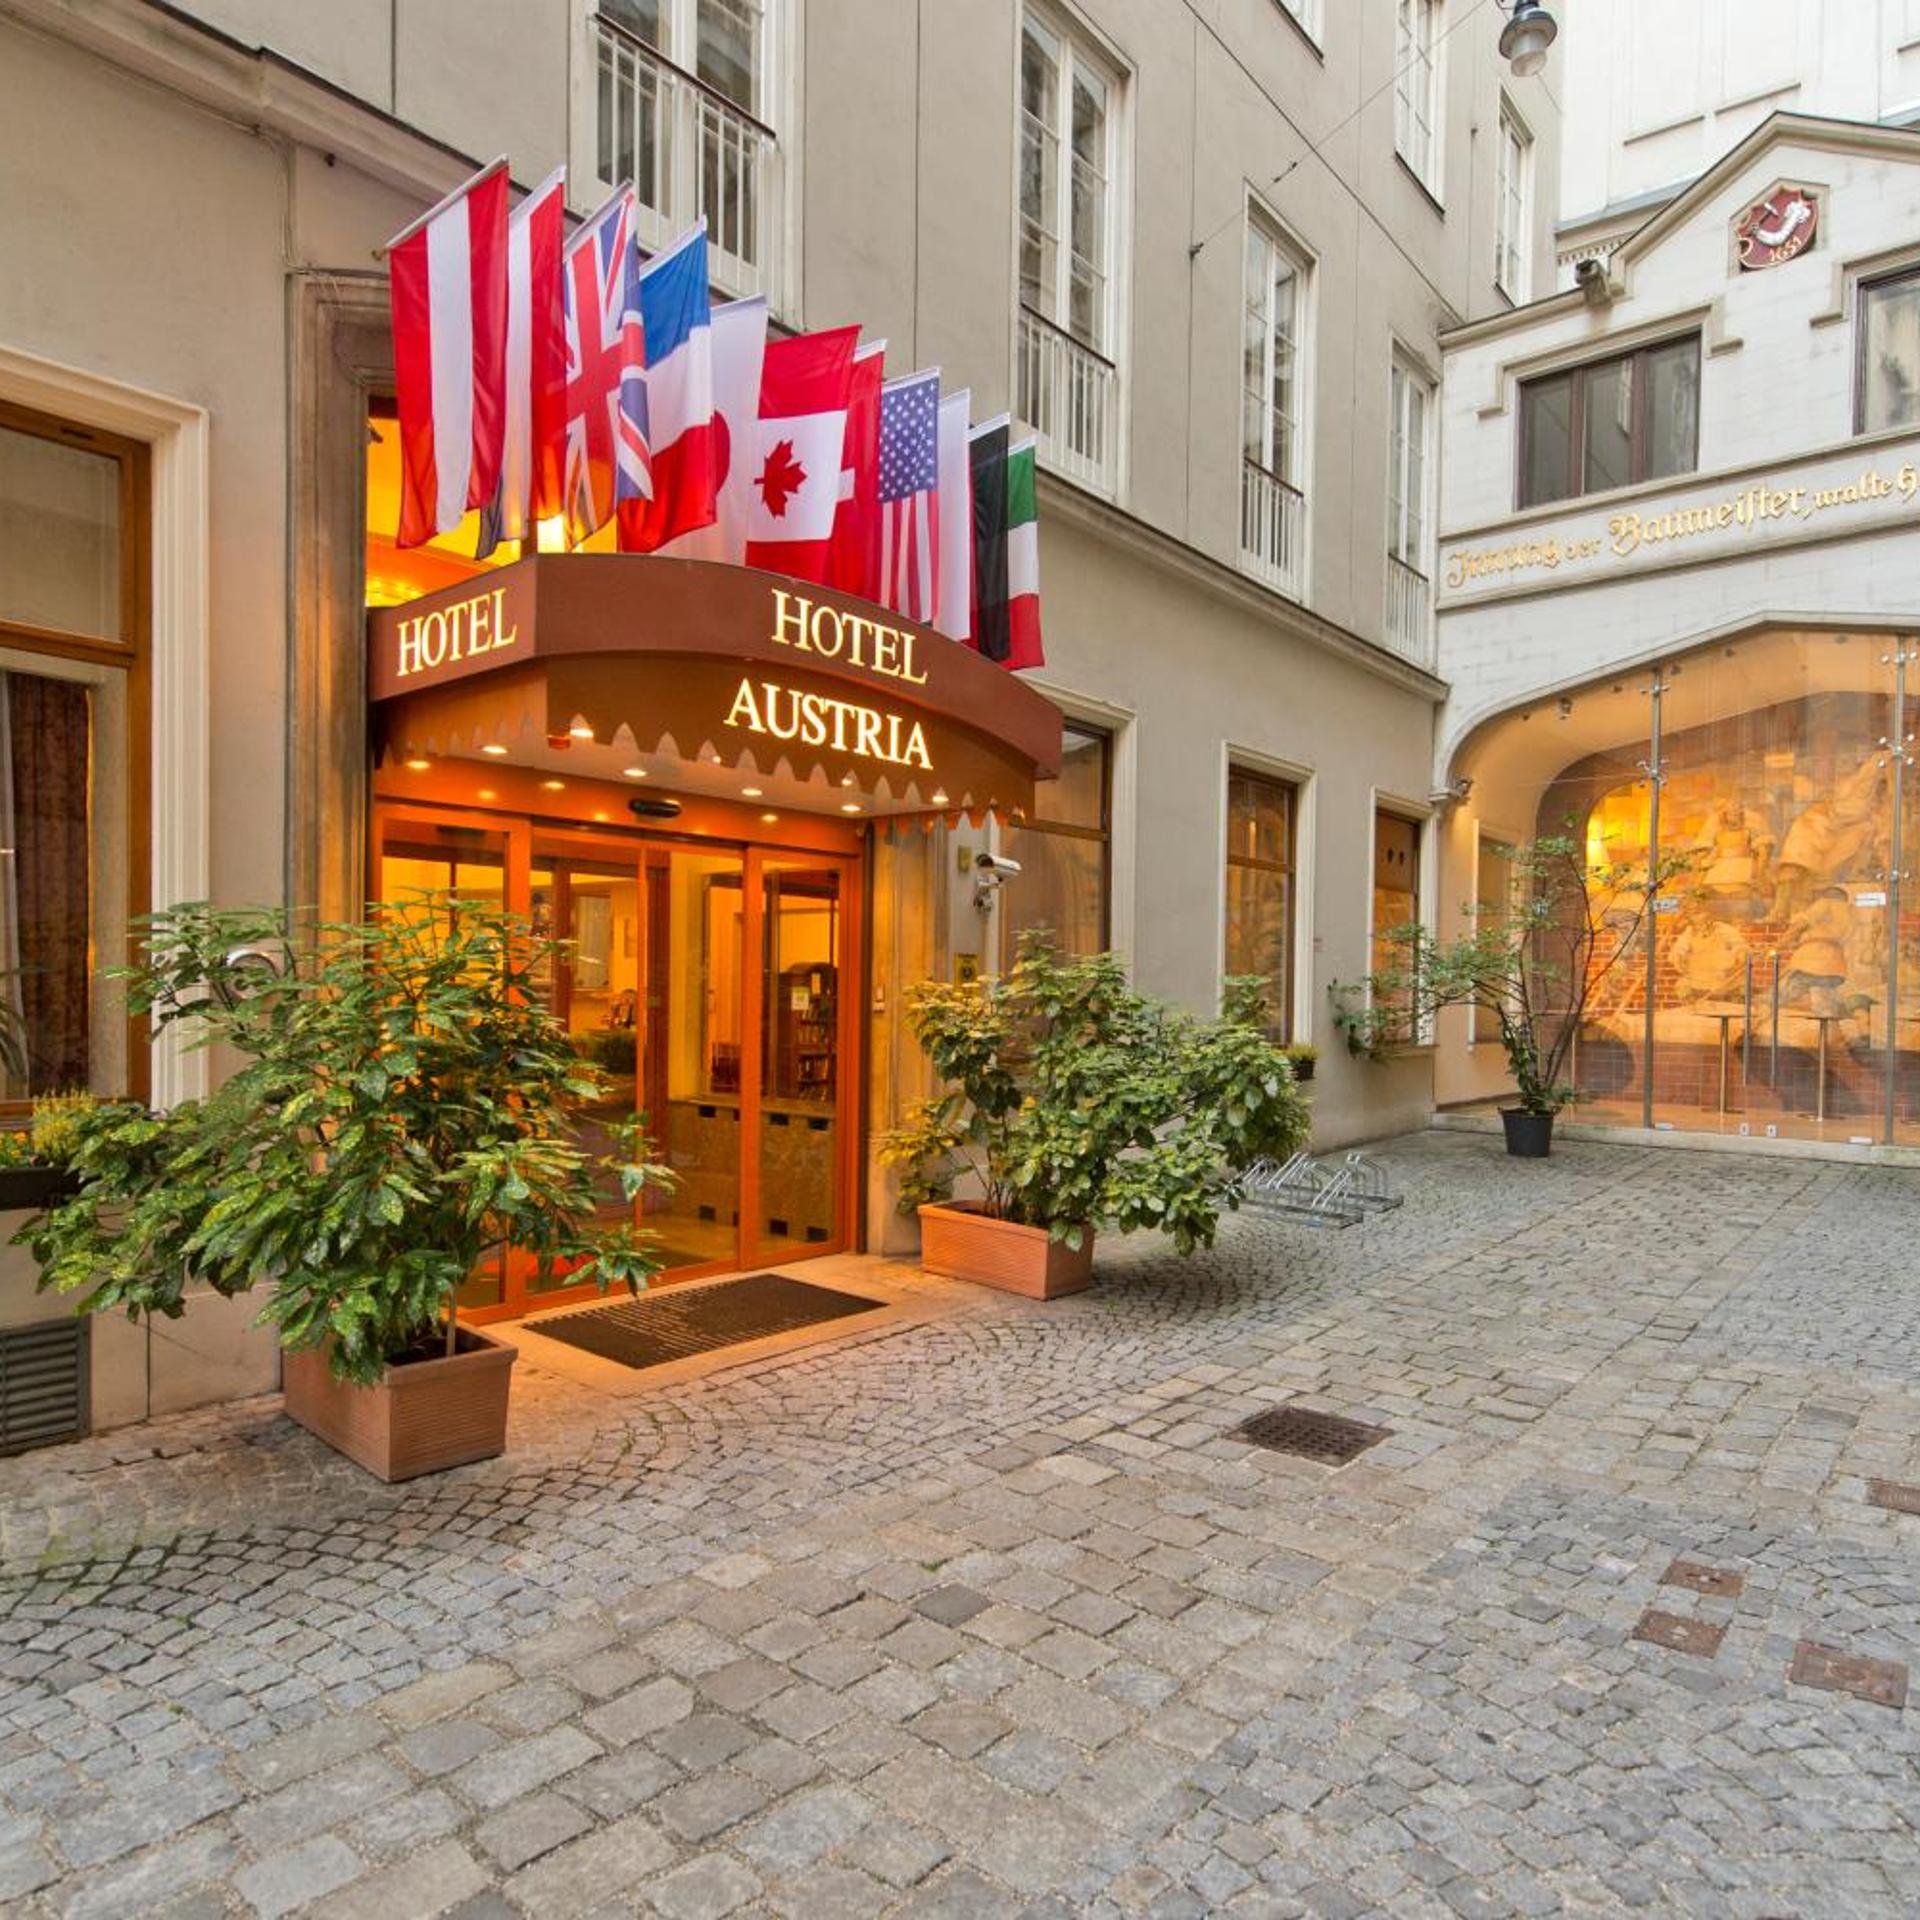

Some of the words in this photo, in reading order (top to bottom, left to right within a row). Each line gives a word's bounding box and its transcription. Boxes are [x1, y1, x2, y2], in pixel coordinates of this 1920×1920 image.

[395, 588, 517, 677] HOTEL
[771, 588, 929, 685] HOTEL
[723, 677, 935, 771] AUSTRIA
